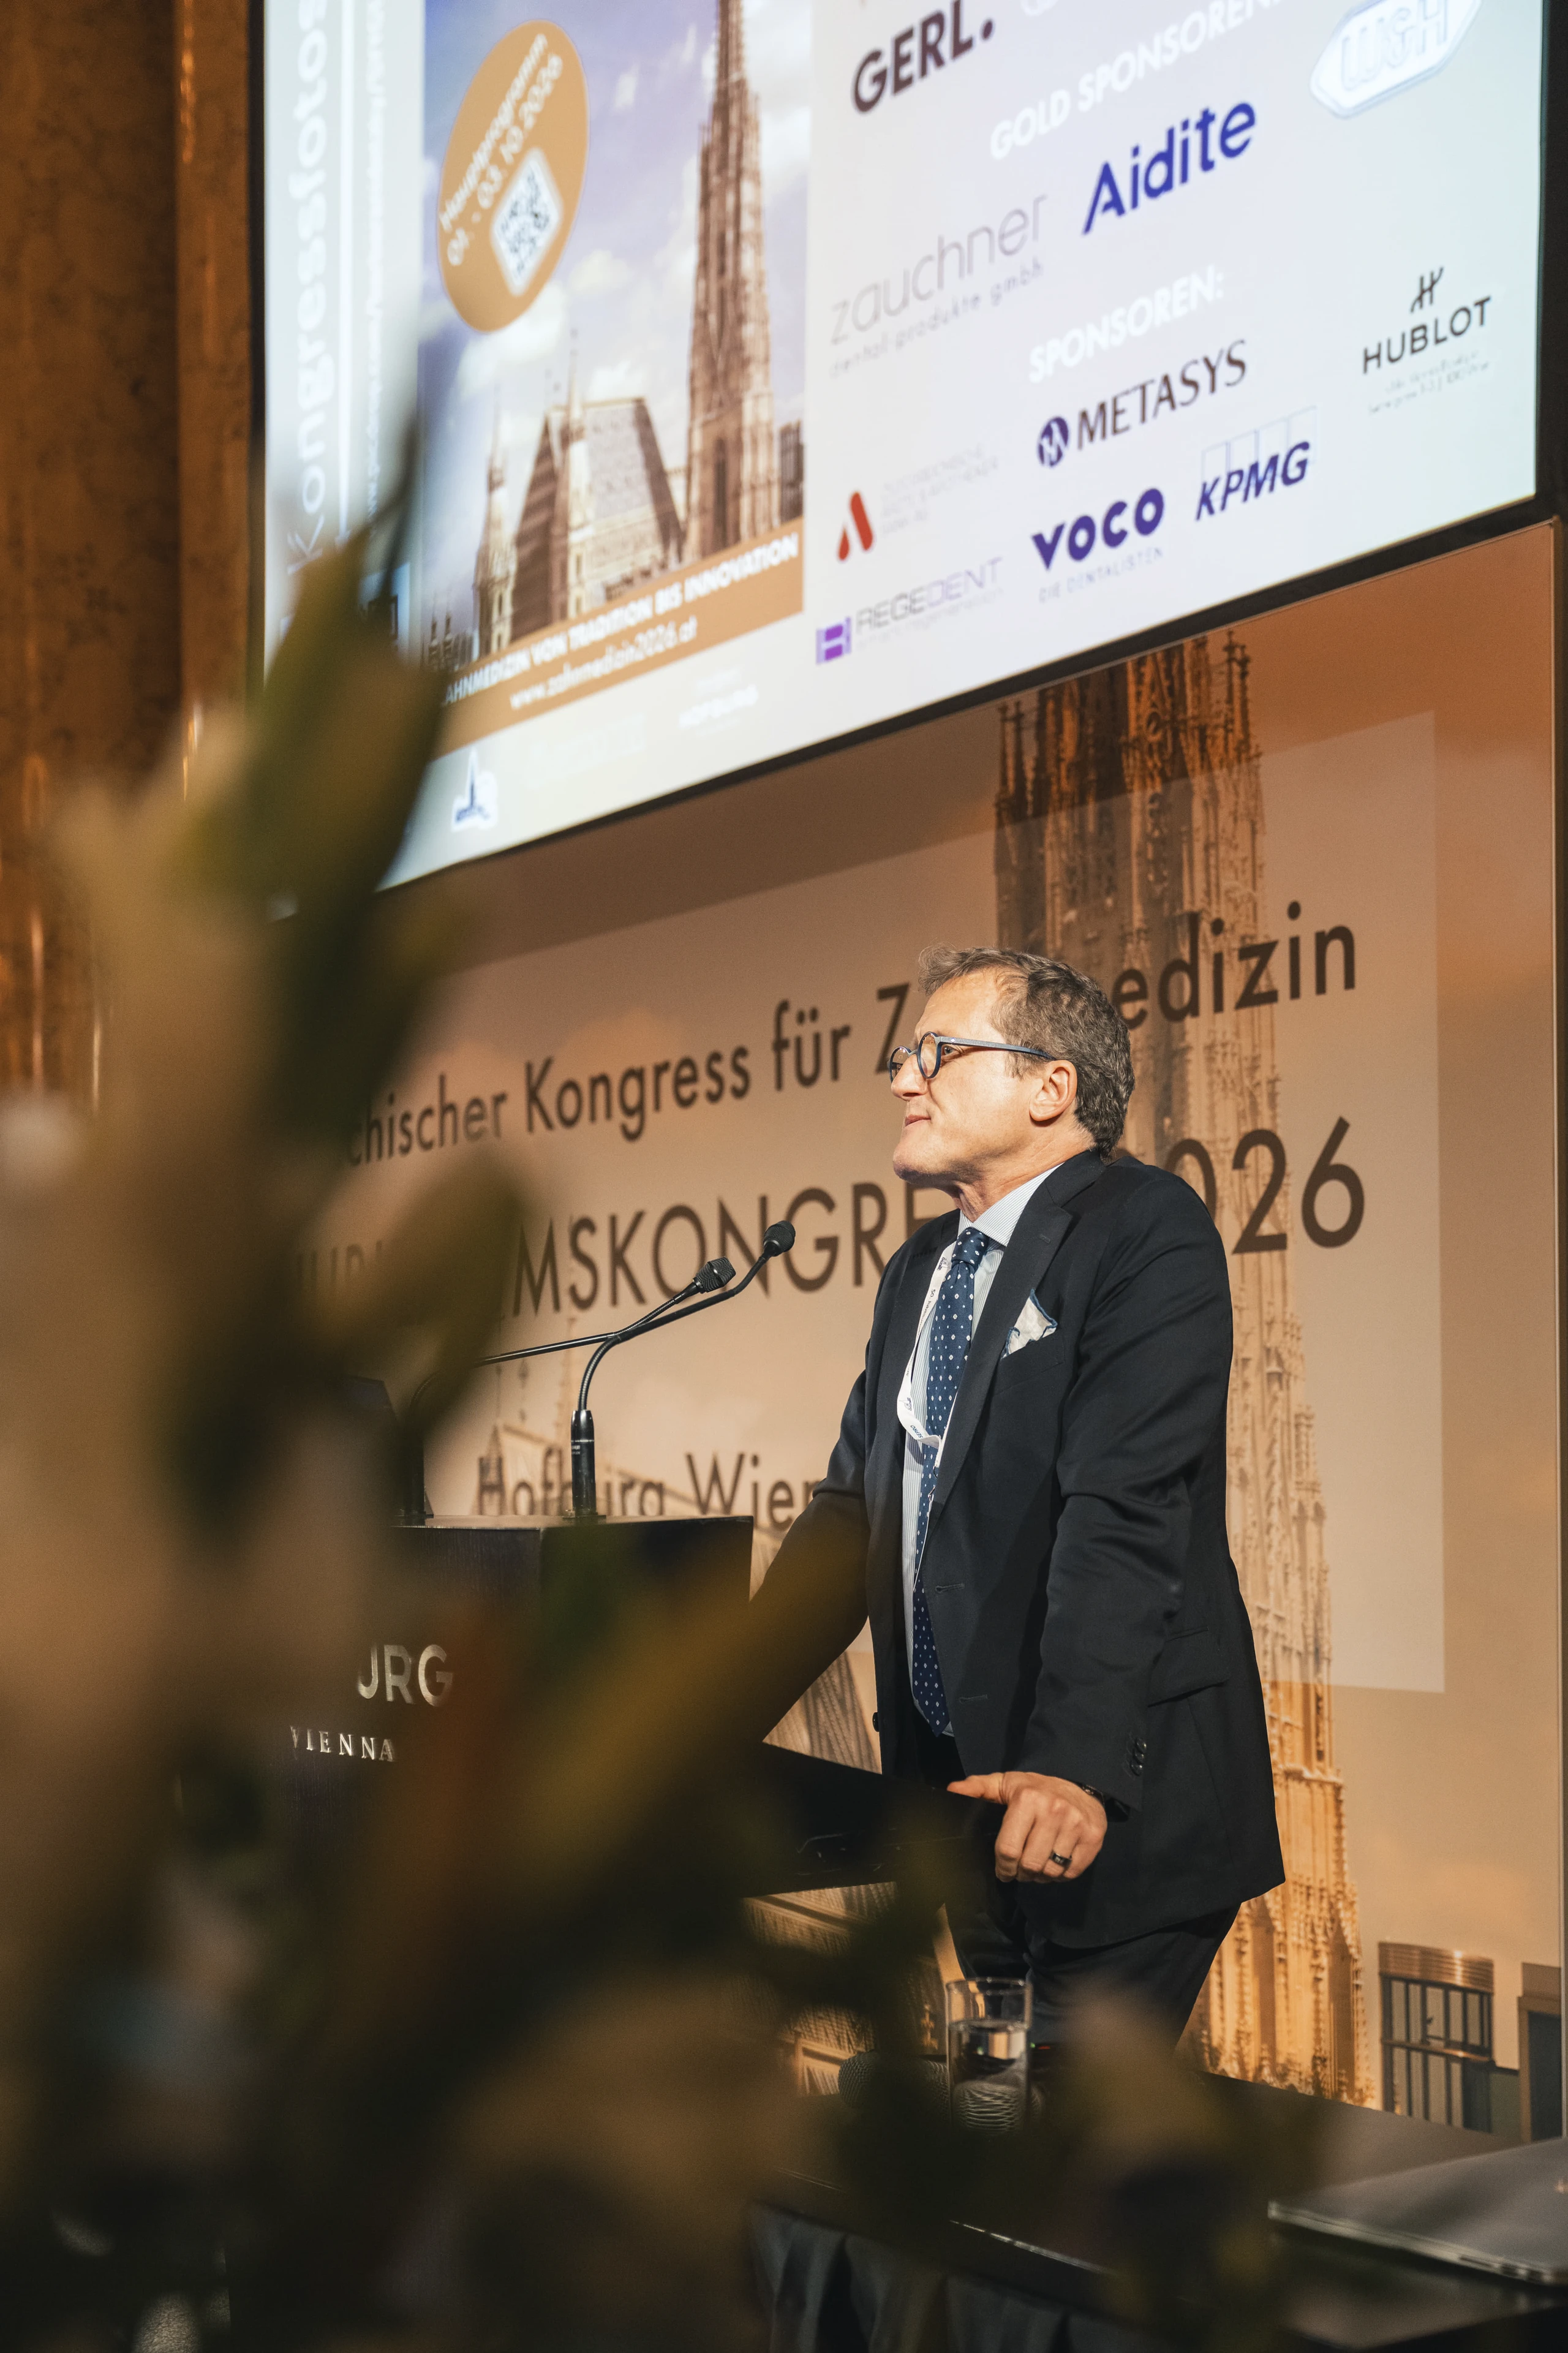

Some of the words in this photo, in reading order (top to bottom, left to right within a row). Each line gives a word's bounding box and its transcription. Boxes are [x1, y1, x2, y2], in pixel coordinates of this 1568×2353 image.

[852, 0, 995, 115] GERL.
[990, 88, 1071, 160] GOLD
[1077, 0, 1281, 113] SPONSORE
[1082, 100, 1257, 236] Aidite
[830, 194, 1049, 346] zauchner
[1029, 265, 1225, 383] SPONSOREN:
[1076, 338, 1247, 451] METASYS
[1362, 296, 1492, 375] HUBLOT
[1195, 440, 1310, 522] KPMG
[442, 647, 532, 707] AHNMEDIZIN
[532, 632, 568, 667] VON
[569, 595, 654, 652] TRADITION
[655, 581, 684, 615] BIS
[685, 531, 799, 603] INNOVATION
[856, 556, 1003, 635] REGEDENT
[524, 1045, 750, 1142] Kongress
[772, 999, 851, 1092] für
[1112, 1116, 1365, 1255] 026
[289, 1725, 395, 1763] VIENNA
